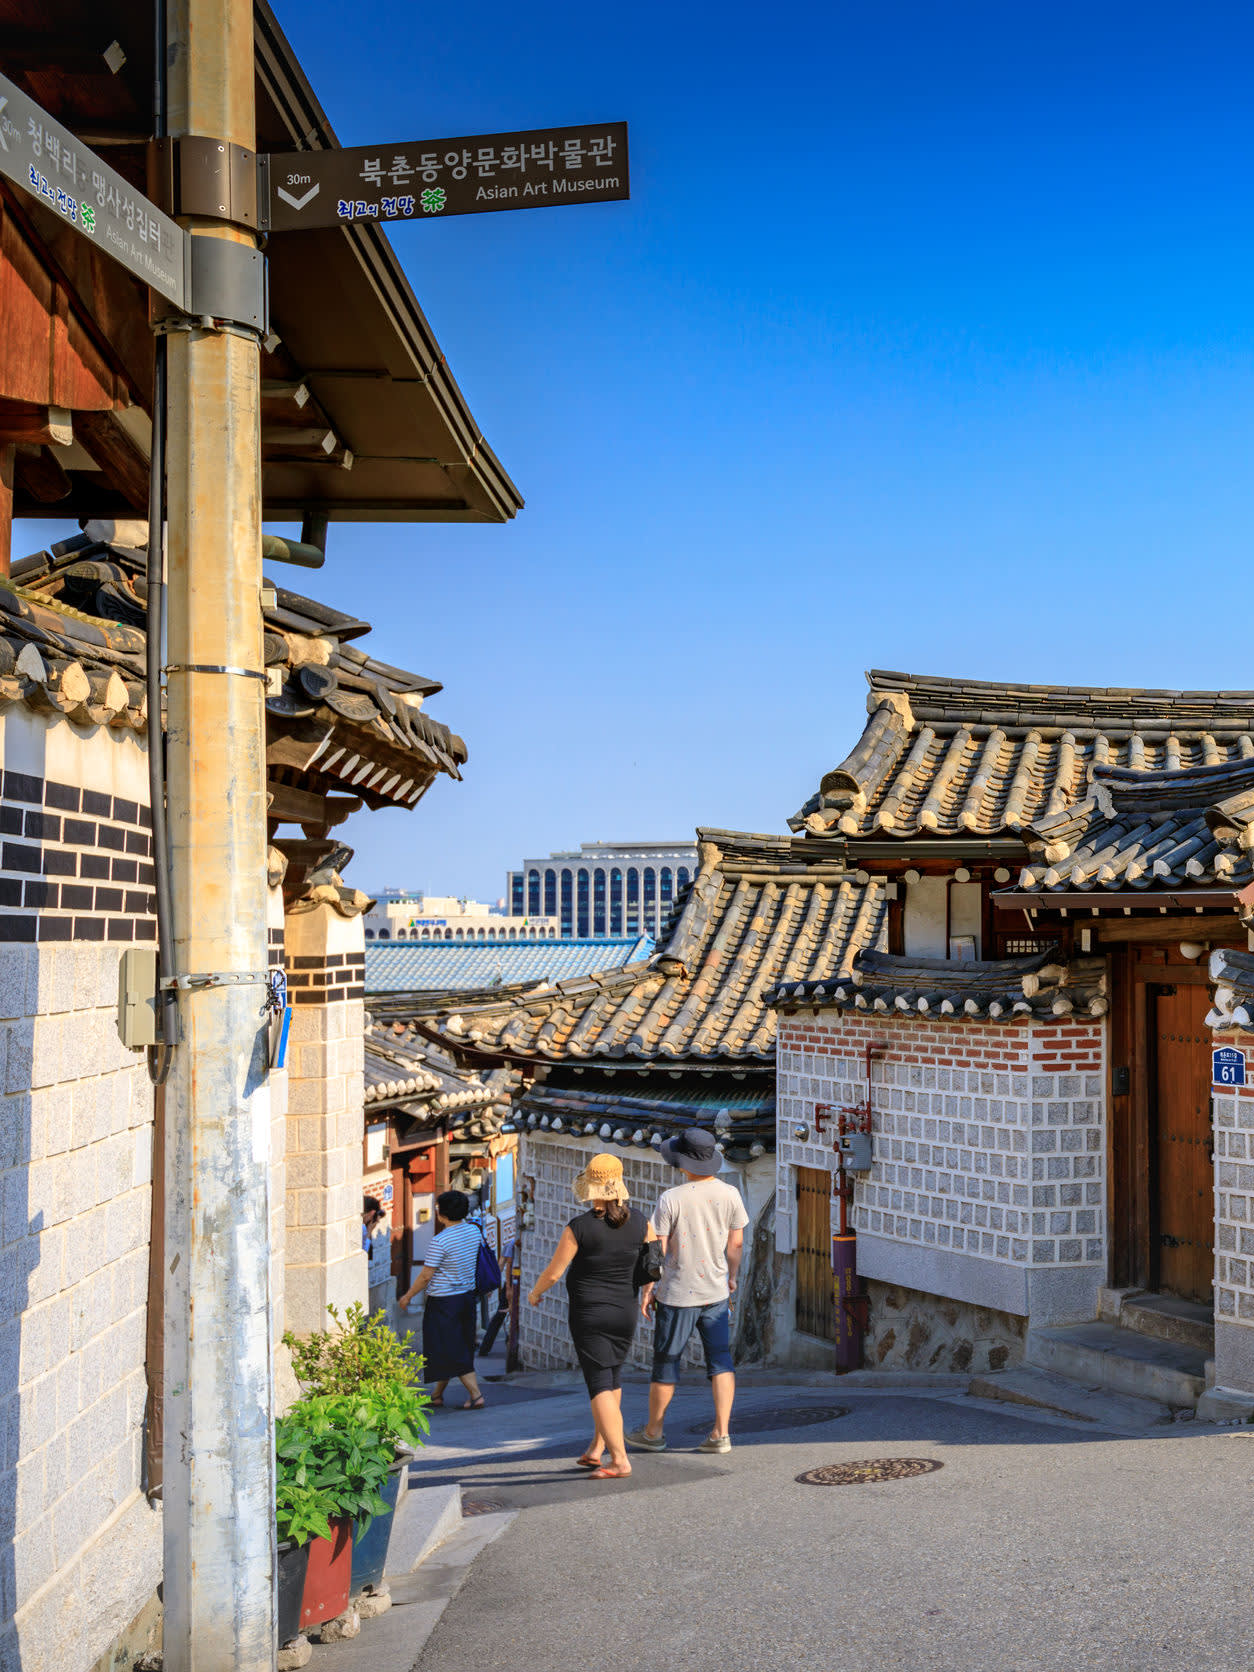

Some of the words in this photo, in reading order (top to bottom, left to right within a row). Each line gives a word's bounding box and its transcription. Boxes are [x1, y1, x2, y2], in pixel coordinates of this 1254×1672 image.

[2, 116, 21, 142] 30m
[358, 135, 617, 188] 북촌동양문화박물관
[286, 173, 311, 186] 30m
[475, 184, 519, 202] Asian
[522, 180, 548, 197] Art
[551, 175, 620, 194] Museum
[28, 163, 56, 206] 최고의
[57, 186, 78, 222] 전망
[80, 202, 96, 234] 茶
[336, 199, 379, 220] 최고의
[380, 195, 414, 216] 전망
[420, 187, 447, 214] 茶
[106, 225, 129, 253] Asian
[130, 245, 144, 265] Art
[144, 254, 177, 289] Museum
[1221, 1066, 1236, 1082] 61
